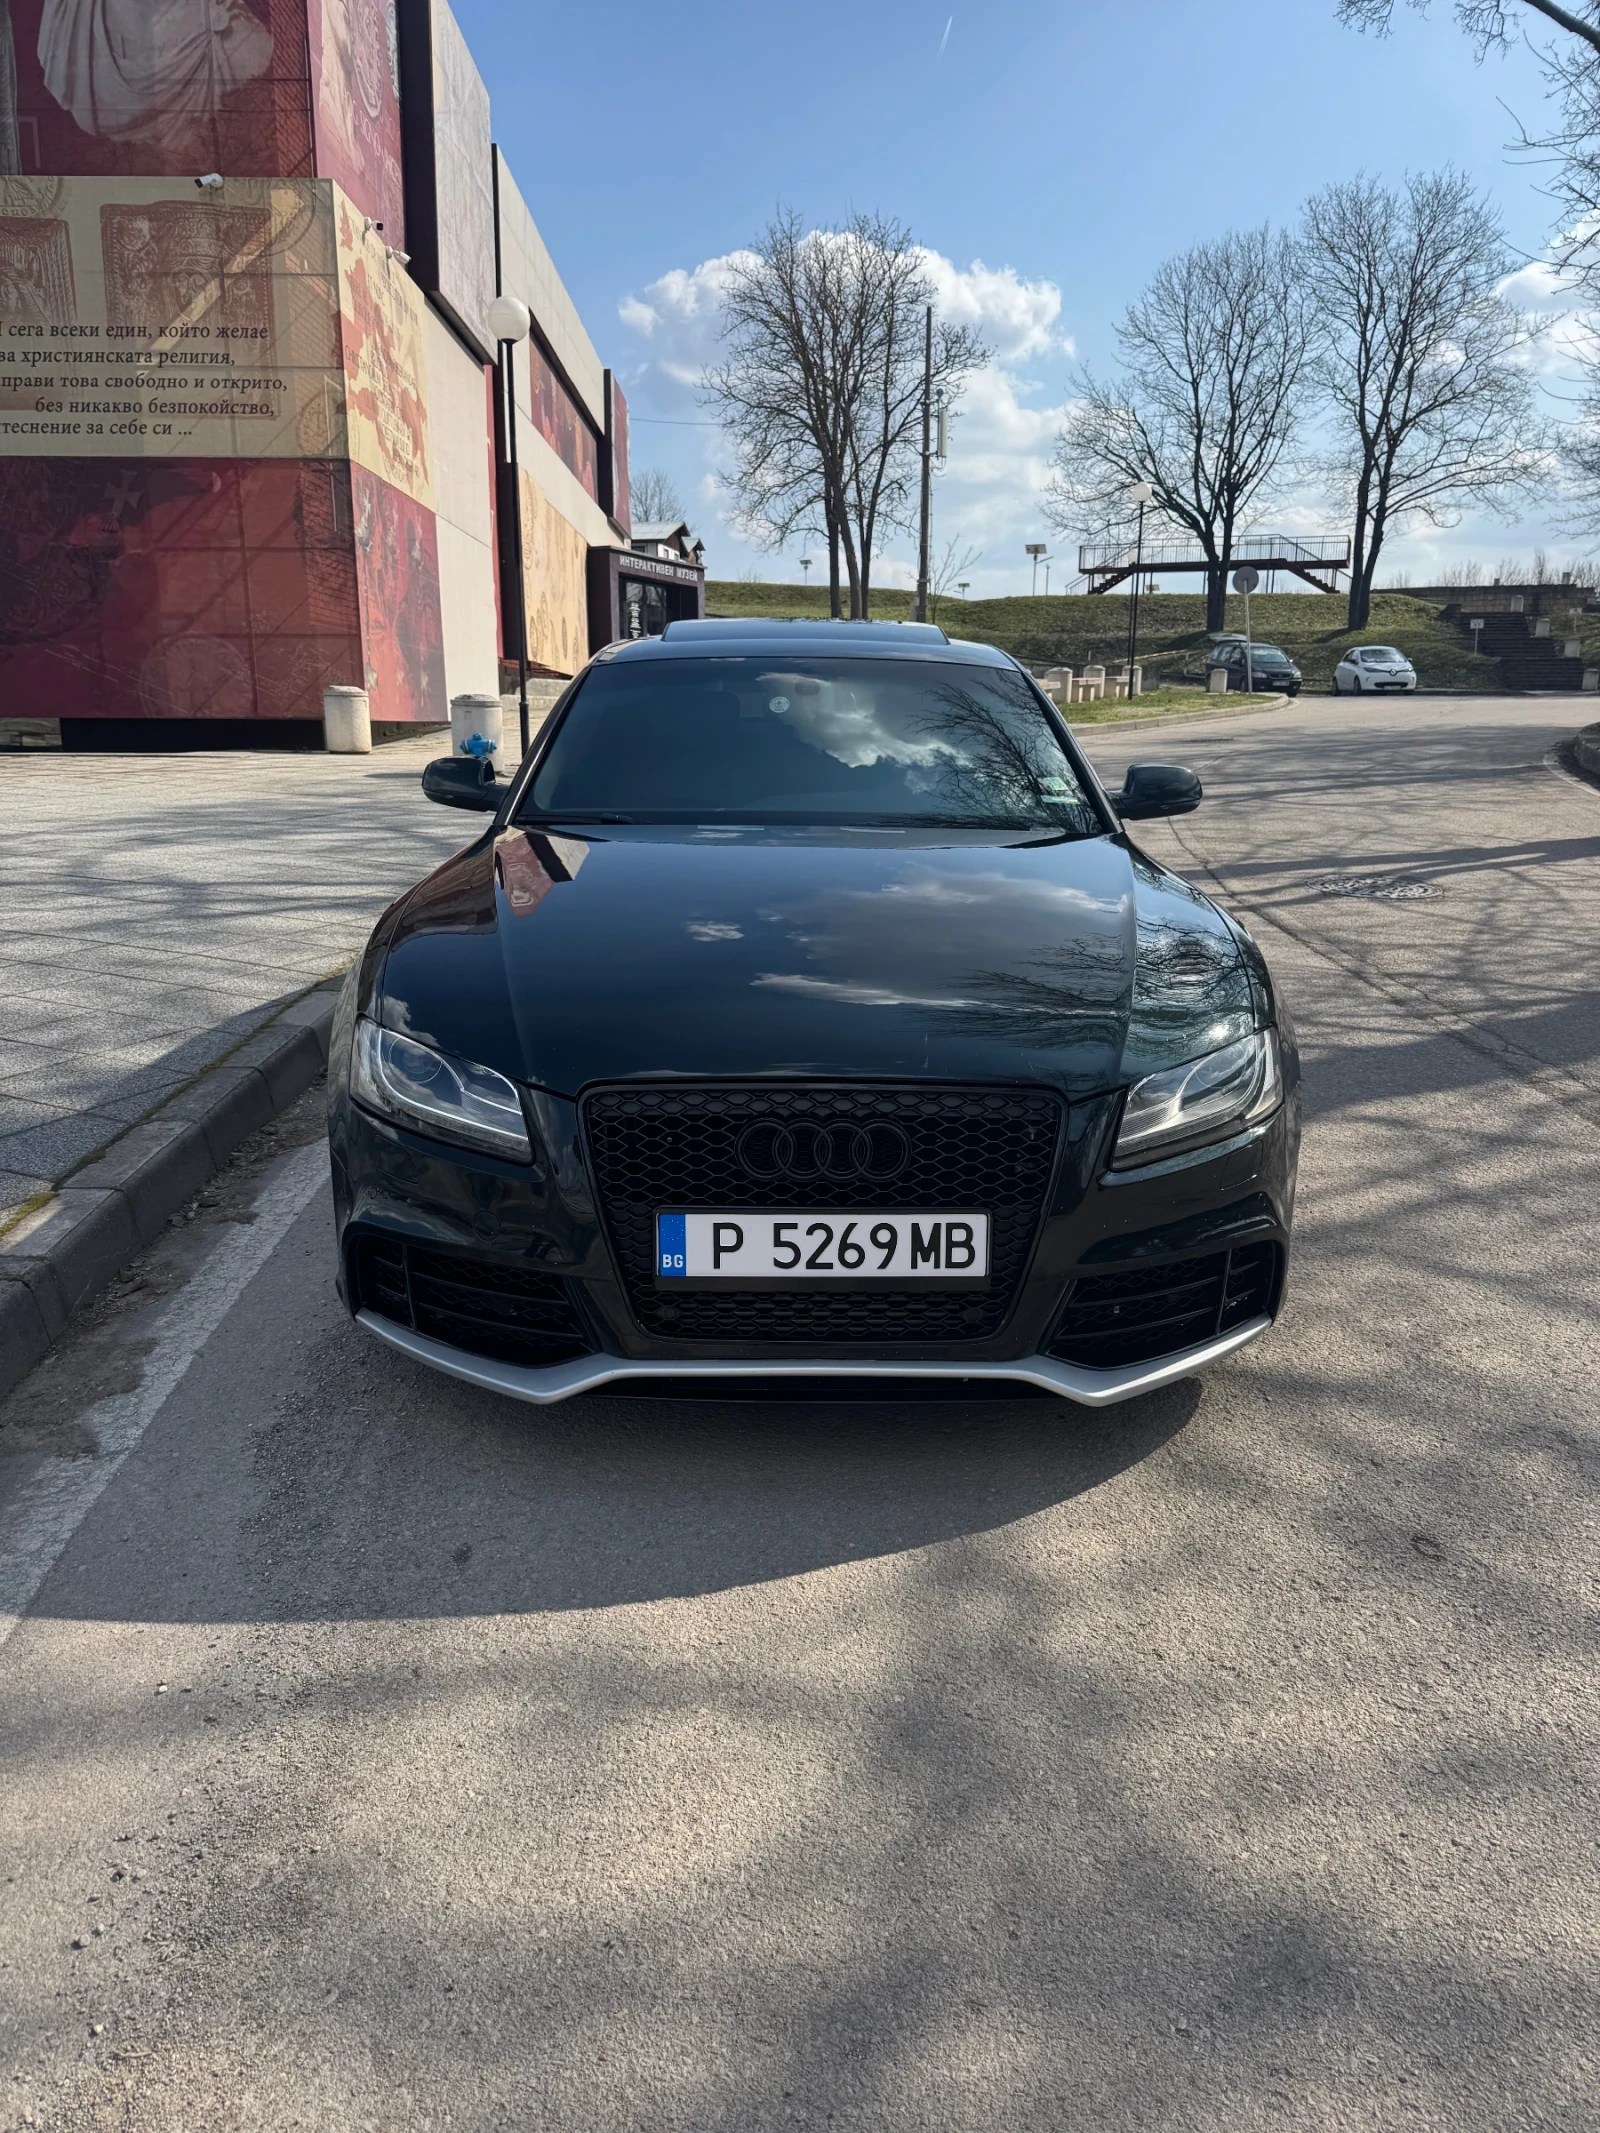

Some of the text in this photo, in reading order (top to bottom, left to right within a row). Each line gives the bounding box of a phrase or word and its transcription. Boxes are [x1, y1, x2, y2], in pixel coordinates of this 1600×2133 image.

[8, 324, 44, 337] сега
[50, 325, 99, 337] всеки
[105, 325, 152, 340] един,
[159, 322, 210, 339] който
[215, 325, 269, 339] желае
[20, 350, 153, 368] християнската
[158, 351, 235, 368] религия,
[1, 372, 287, 393] прави това свободно и открито,
[35, 396, 275, 416] без никакво безпокойство,
[0, 422, 81, 434] теснение
[86, 423, 104, 435] за
[109, 419, 148, 435] себе
[152, 424, 173, 436] си
[620, 555, 674, 576] ИНТЕРАКТИВЕН
[712, 1222, 976, 1270] P 5269 MB
[662, 1254, 684, 1268] BG
